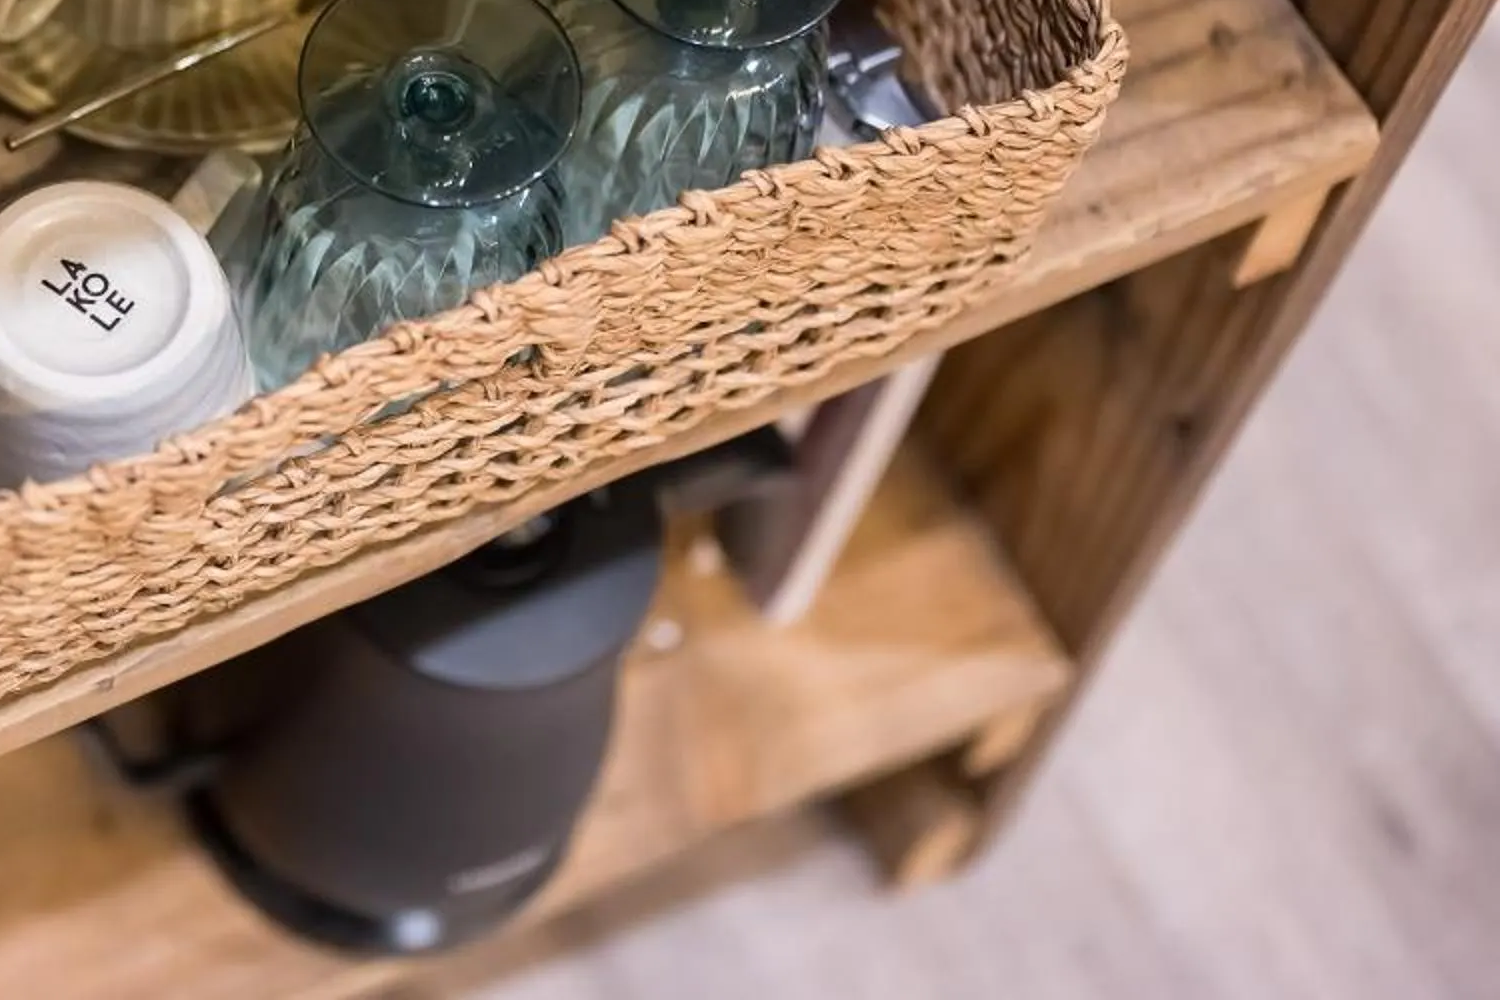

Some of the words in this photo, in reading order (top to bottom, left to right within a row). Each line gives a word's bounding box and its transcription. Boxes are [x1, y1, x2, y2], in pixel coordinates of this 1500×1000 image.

[41, 259, 87, 296] LA
[65, 273, 109, 314] KO
[89, 290, 135, 332] LE
